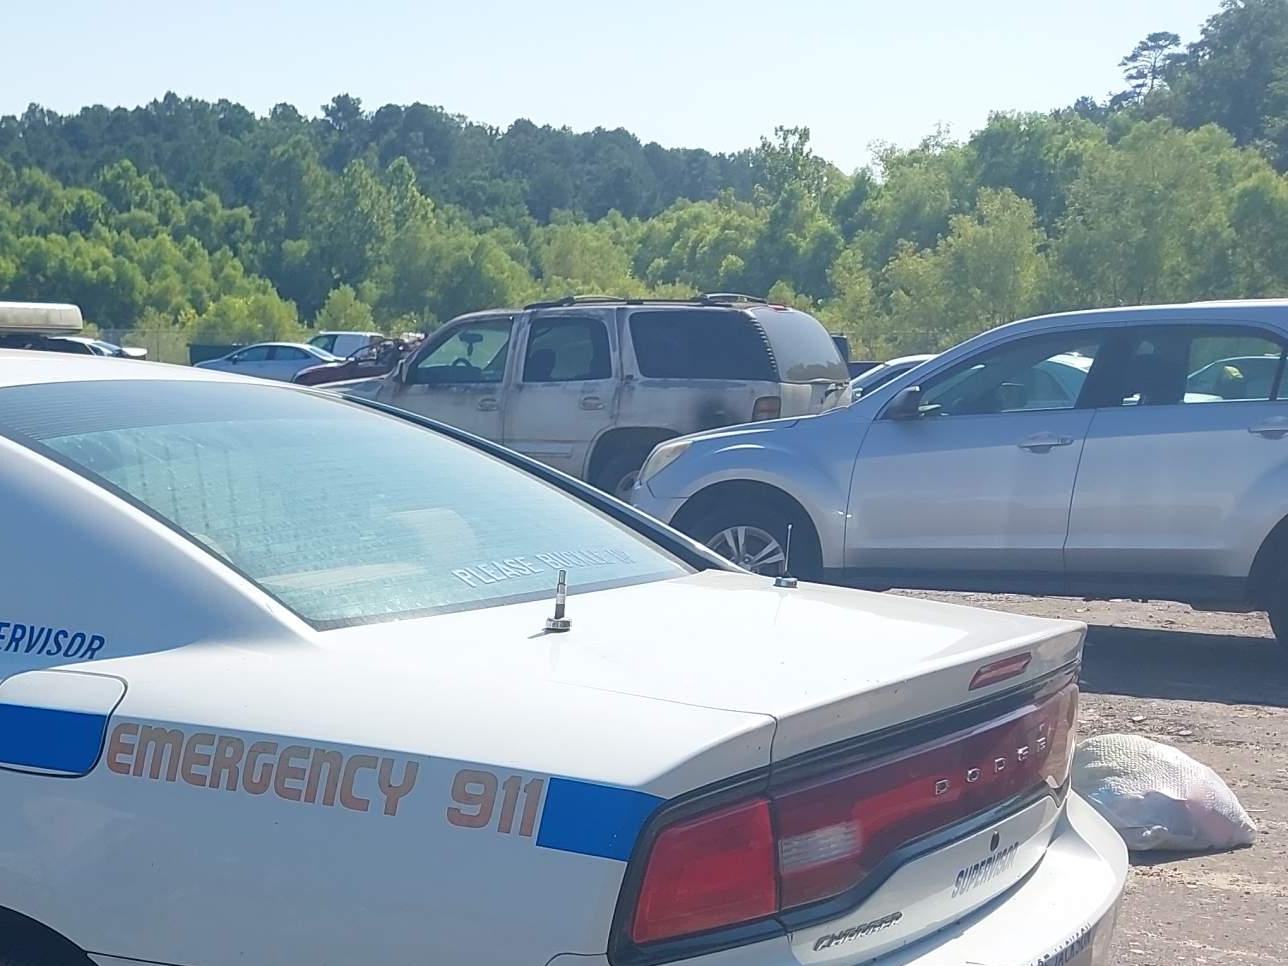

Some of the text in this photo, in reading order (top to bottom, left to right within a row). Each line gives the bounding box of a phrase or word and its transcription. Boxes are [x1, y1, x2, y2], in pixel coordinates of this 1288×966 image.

[451, 556, 544, 588] PLEASE
[106, 722, 544, 838] EMERGENCY 911
[935, 736, 1048, 796] DODGE
[952, 841, 1020, 898] SUPERVISOR
